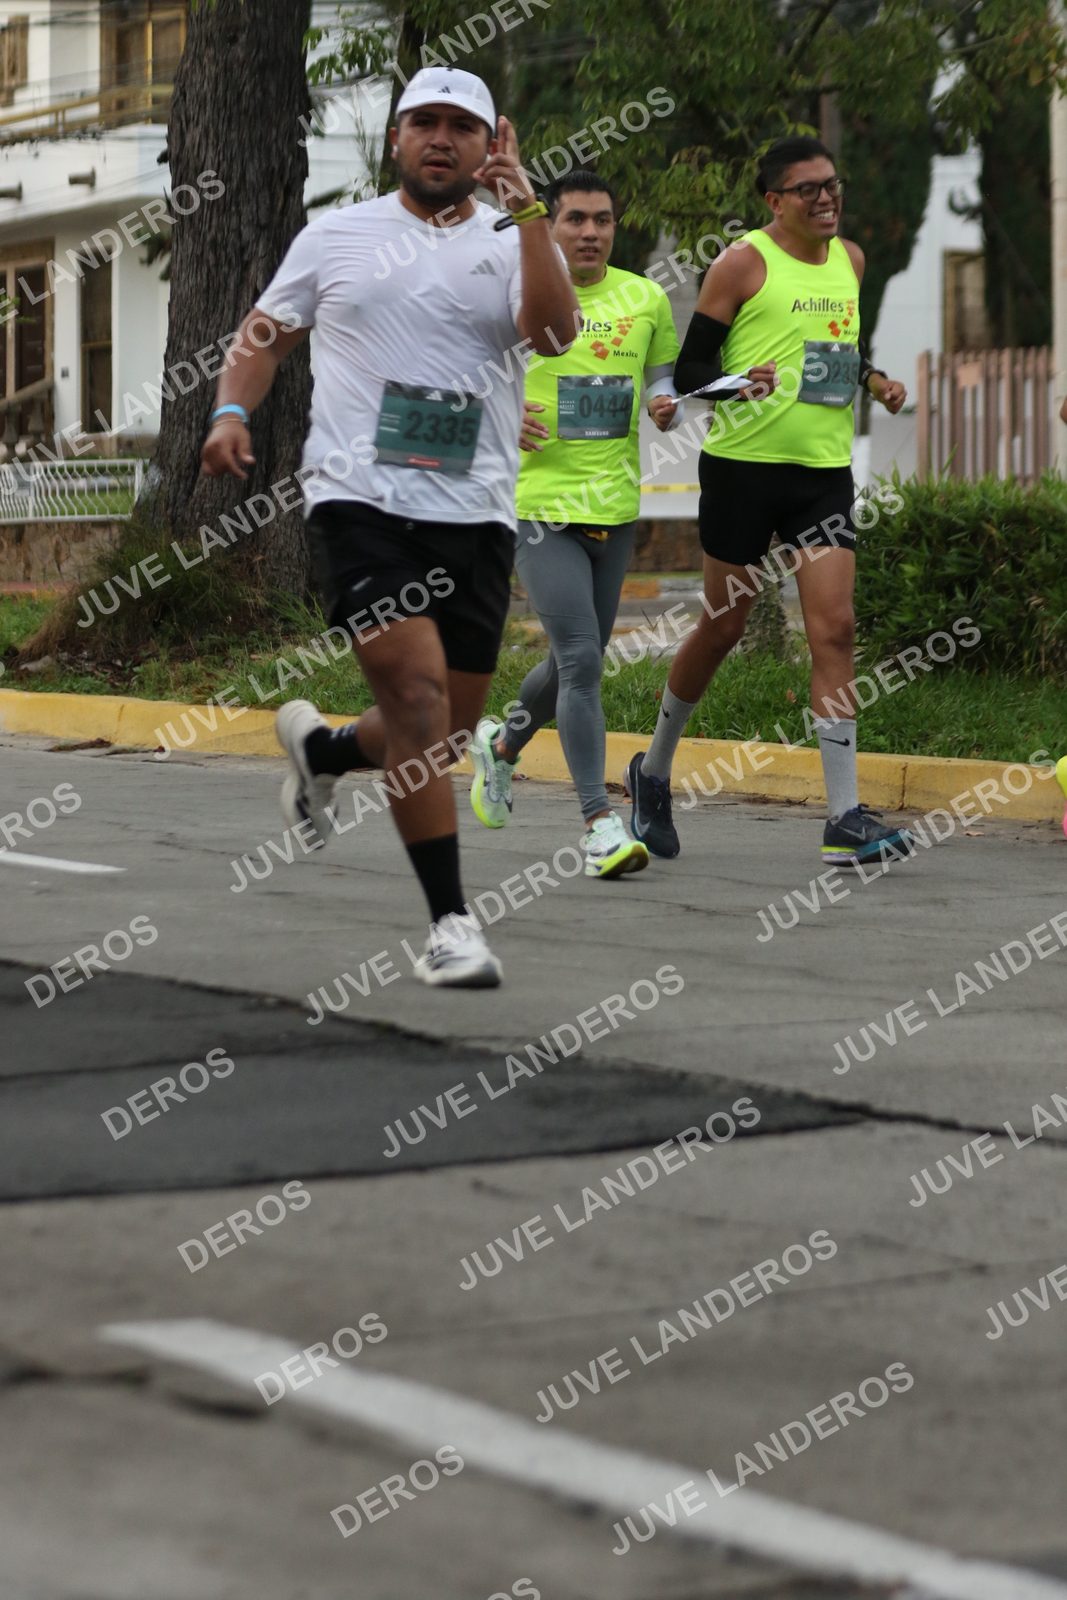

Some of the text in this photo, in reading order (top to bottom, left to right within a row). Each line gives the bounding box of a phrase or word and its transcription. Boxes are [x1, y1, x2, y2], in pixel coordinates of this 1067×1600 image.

[791, 297, 844, 313] Achilles
[580, 319, 612, 333] lles
[613, 349, 639, 358] Mexico
[579, 394, 631, 419] 0444
[403, 410, 478, 447] 2335
